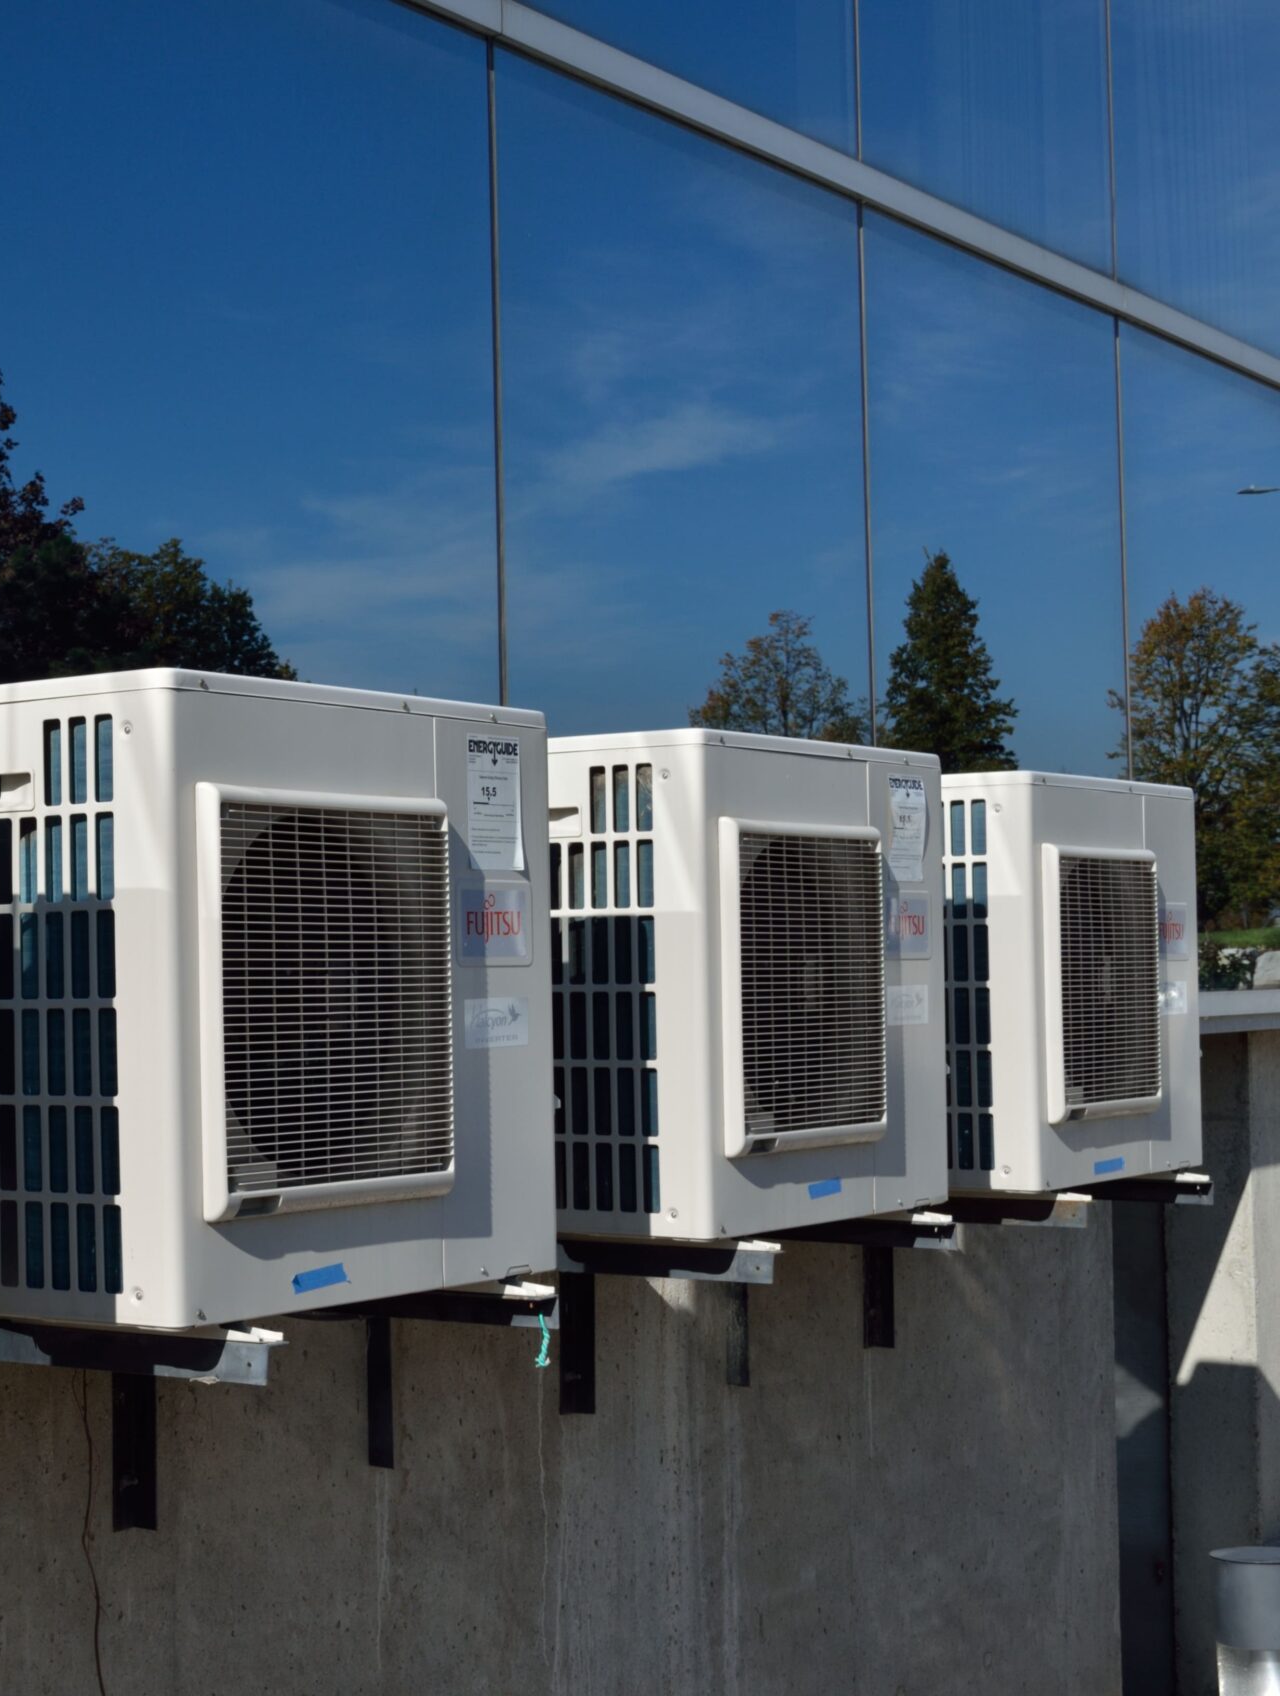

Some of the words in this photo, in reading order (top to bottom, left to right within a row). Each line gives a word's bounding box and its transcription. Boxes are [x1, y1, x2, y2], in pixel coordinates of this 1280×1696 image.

[468, 739, 519, 756] ENERGYGUIDE
[481, 786, 497, 797] 15.5
[466, 911, 521, 944] FUJITSU
[888, 915, 925, 938] UJITSU
